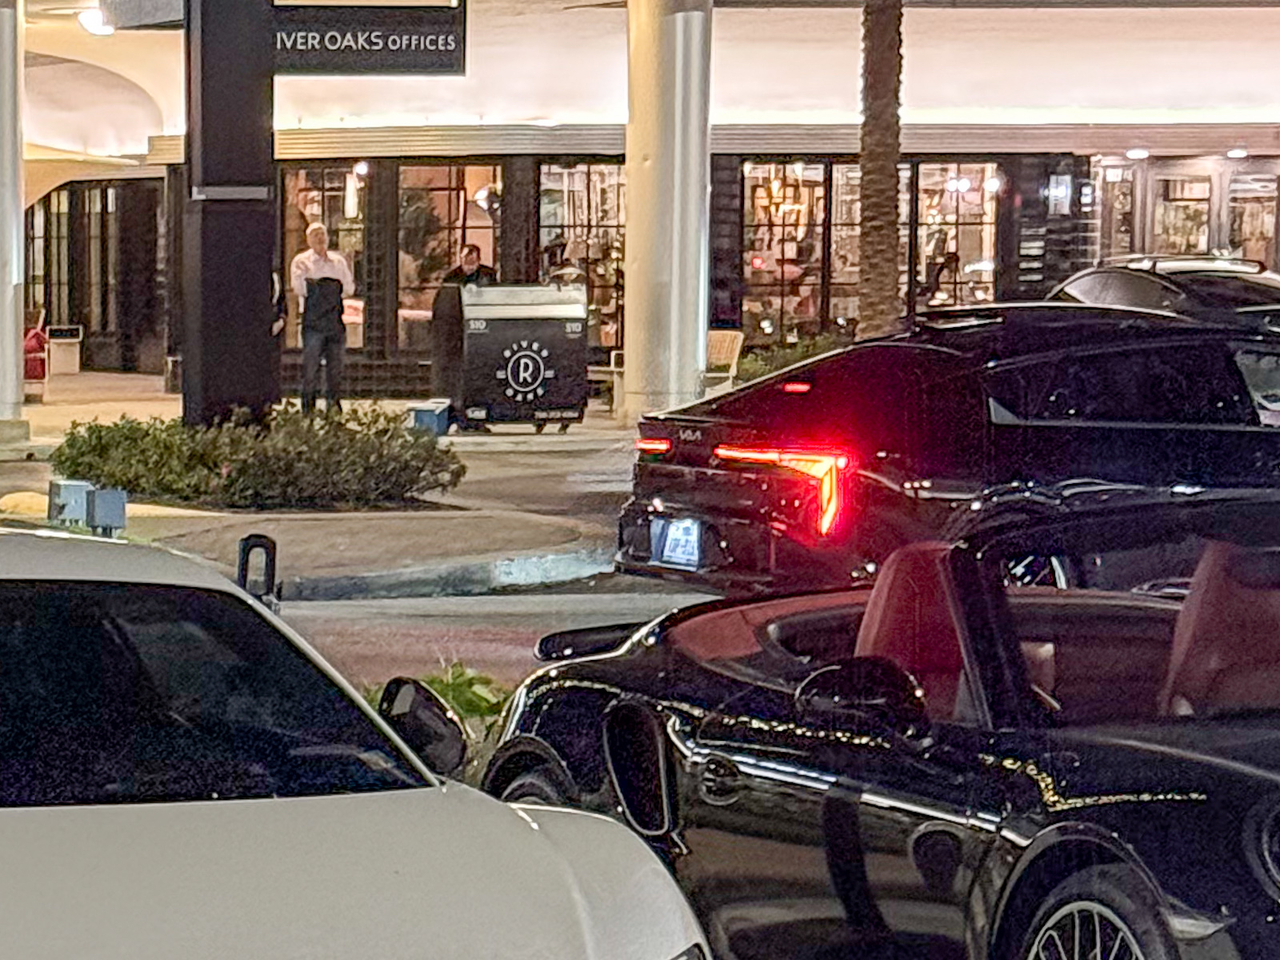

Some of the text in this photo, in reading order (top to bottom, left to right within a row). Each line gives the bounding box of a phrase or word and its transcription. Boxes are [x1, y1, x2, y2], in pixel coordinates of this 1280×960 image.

[276, 31, 456, 50] IVER OAKS OFFICES
[519, 358, 532, 383] R
